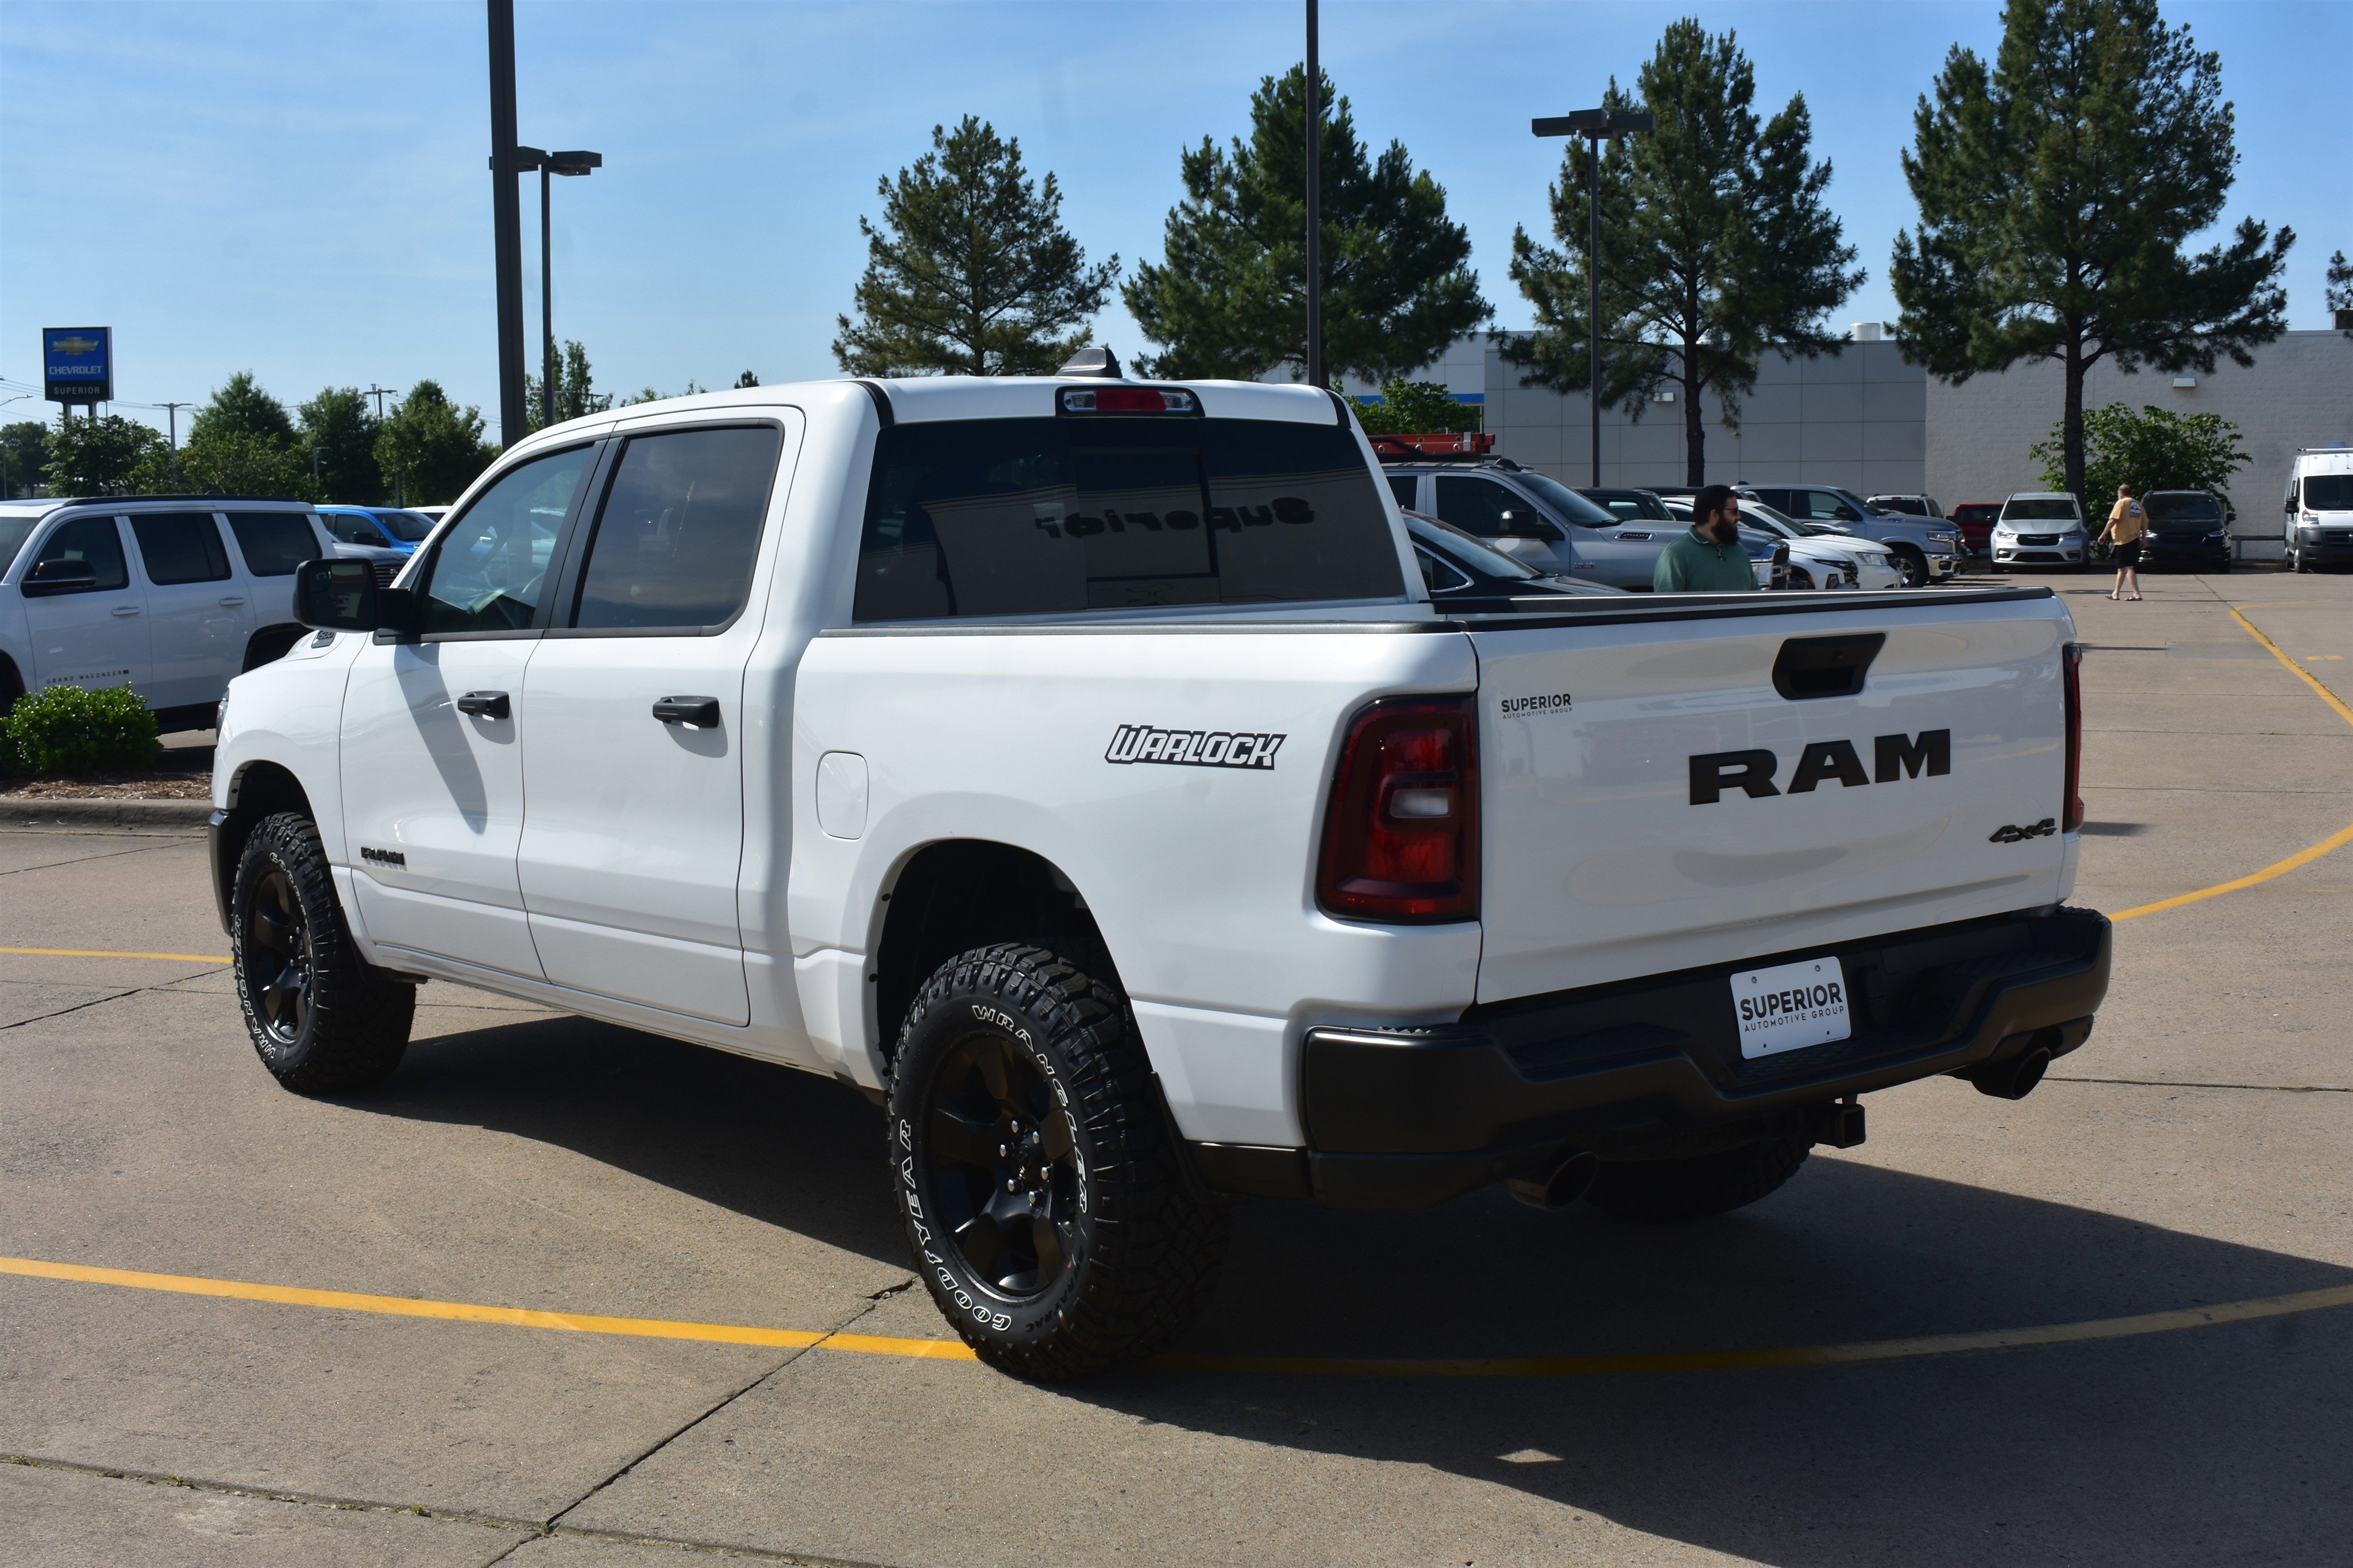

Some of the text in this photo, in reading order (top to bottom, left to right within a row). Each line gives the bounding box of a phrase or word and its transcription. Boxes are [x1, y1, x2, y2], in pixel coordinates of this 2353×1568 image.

[49, 365, 102, 375] CHEVROLET
[54, 387, 100, 395] SUPERIOR
[47, 670, 122, 684] GRAND WAGONEER
[1501, 693, 1572, 713] SUPERIOR
[1503, 710, 1546, 719] AUTOMOTIVE
[1689, 728, 1951, 806] RAM
[234, 914, 276, 1059] WRANGLER
[1739, 982, 1843, 1021] SUPERIOR
[1744, 1006, 1845, 1032] AUTOMOTIVE GROUP
[971, 1005, 1088, 1214] WRANGLER
[899, 1118, 1012, 1331] GOODYEAR
